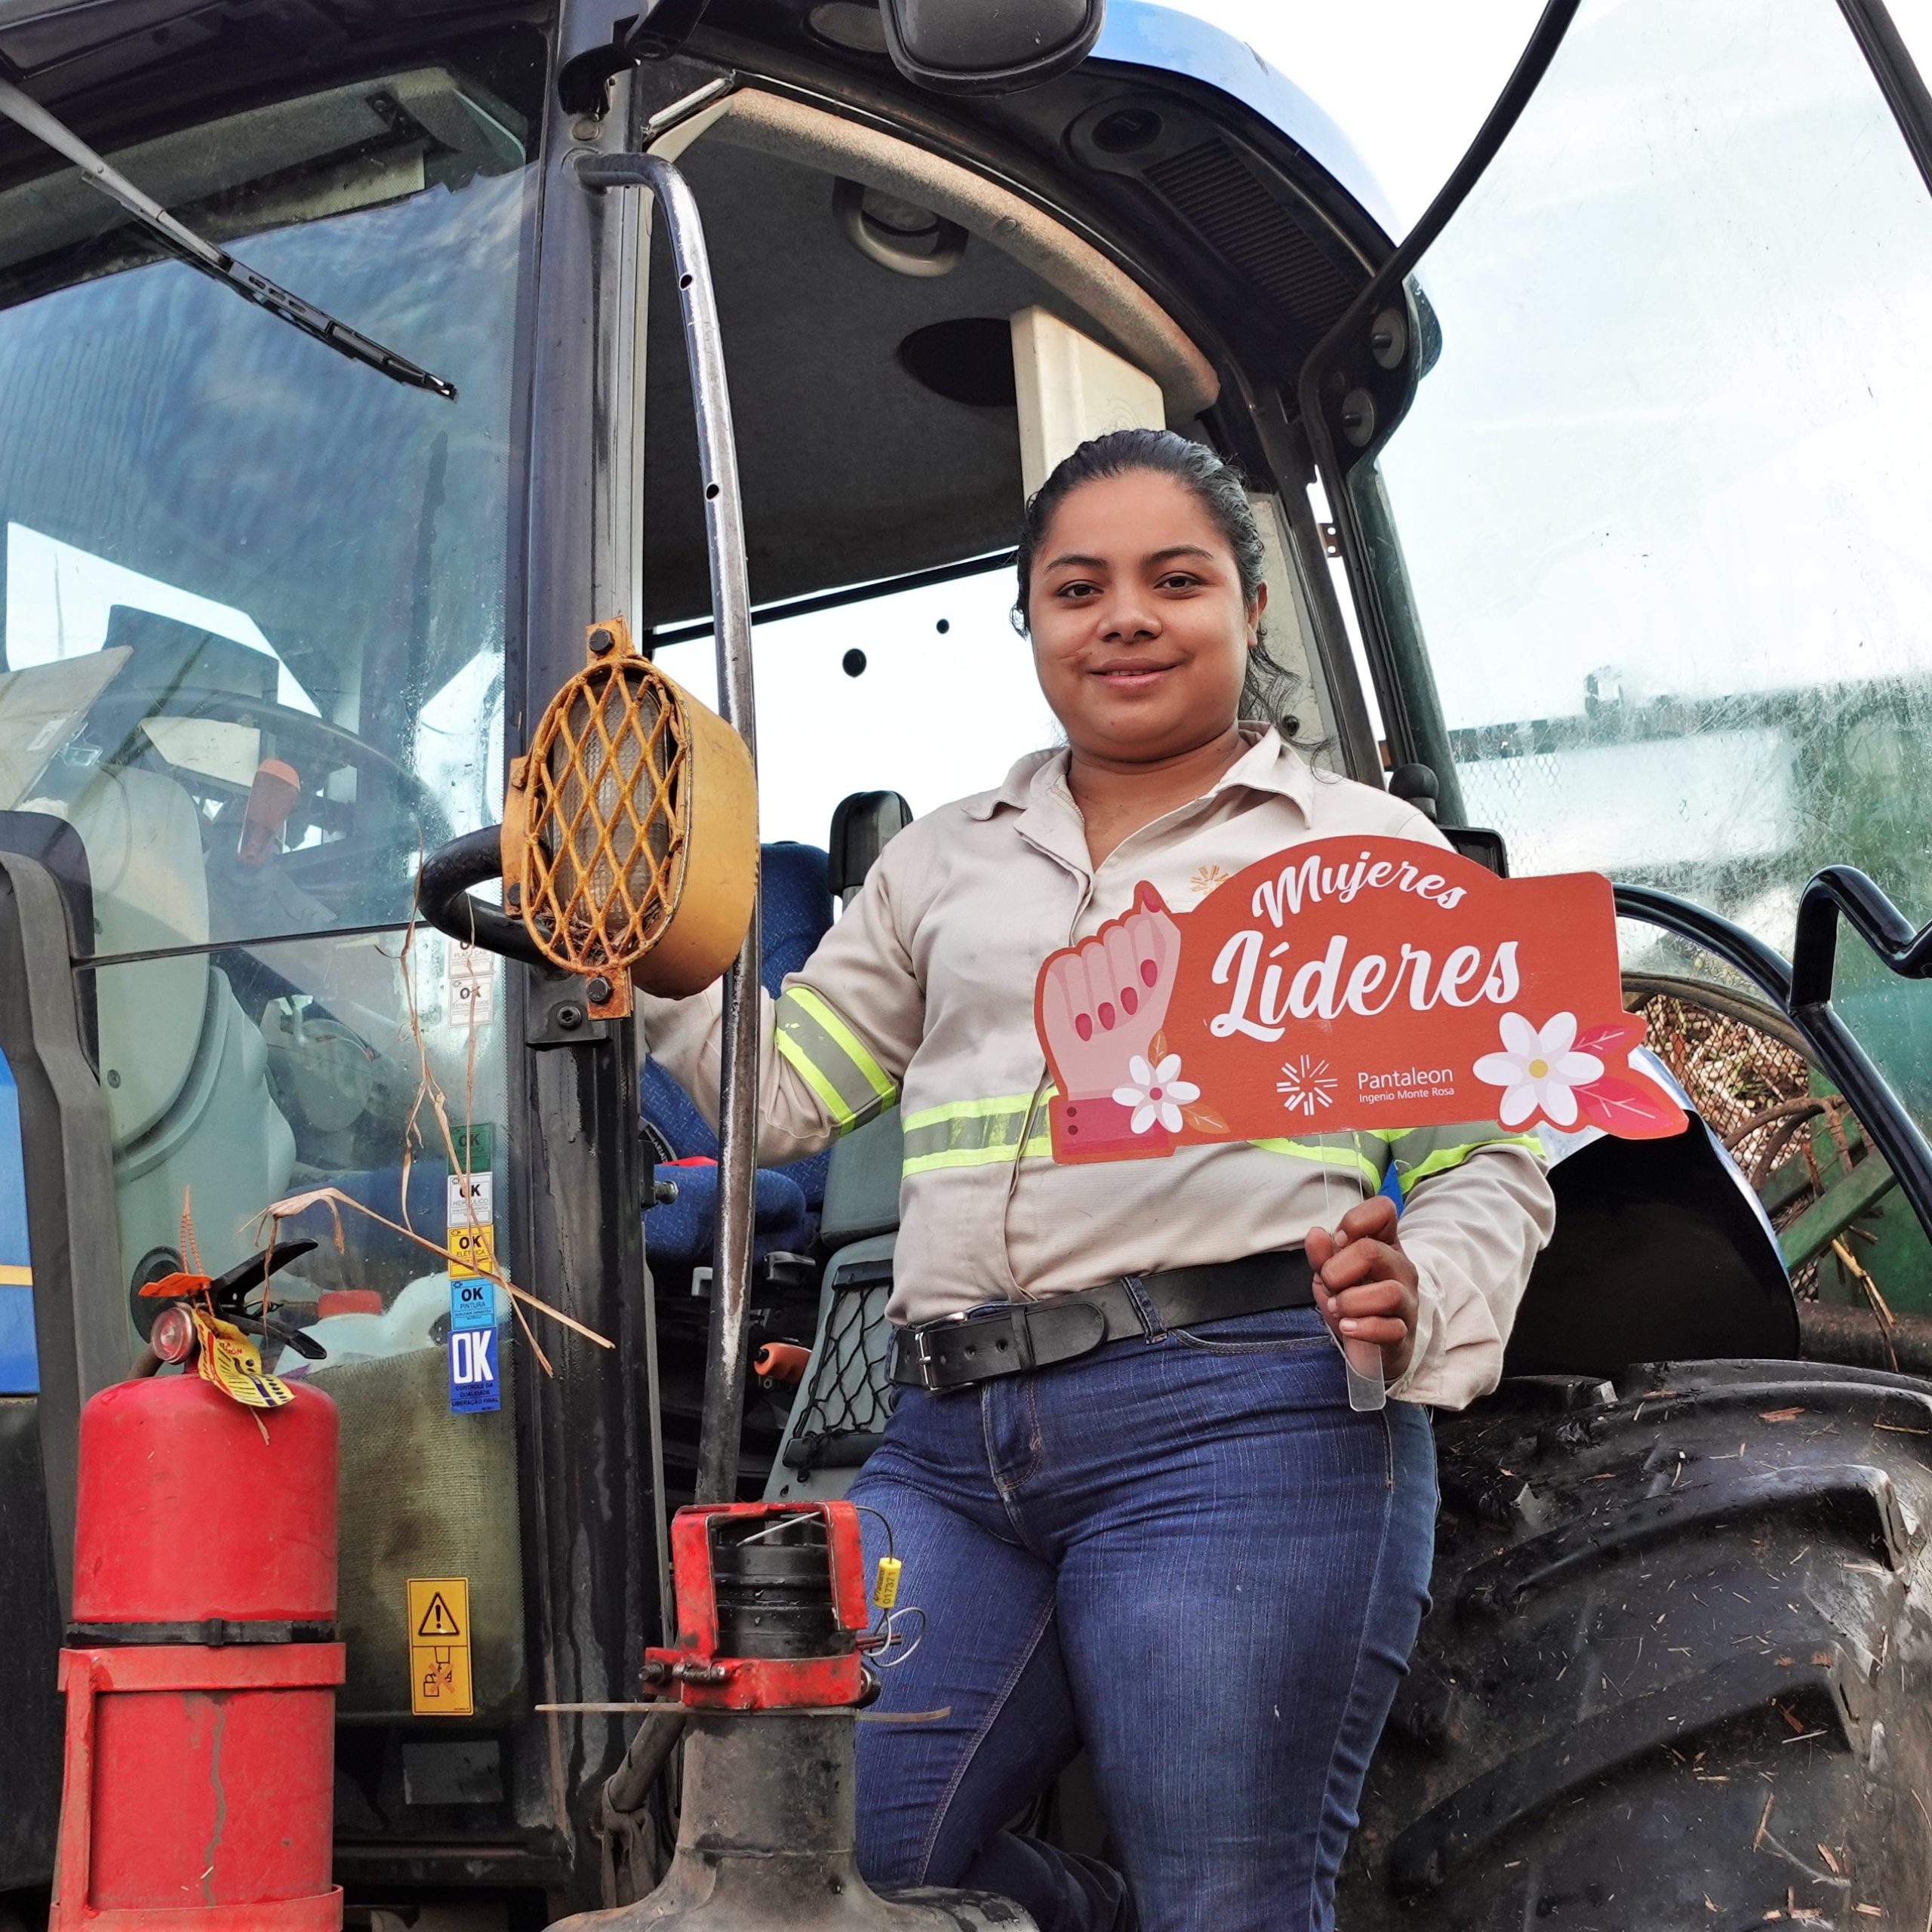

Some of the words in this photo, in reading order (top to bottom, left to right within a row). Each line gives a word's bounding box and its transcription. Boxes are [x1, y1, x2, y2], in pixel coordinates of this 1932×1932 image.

[1252, 850, 1467, 928] Mujeres
[1210, 930, 1520, 1042] Líderes
[1358, 1066, 1454, 1090] Pantaleon
[1358, 1089, 1395, 1105] Ingenio
[1397, 1089, 1429, 1100] Monte
[1431, 1087, 1455, 1097] Rosa
[459, 1133, 481, 1148] OK
[460, 1235, 481, 1250] OK
[460, 1300, 486, 1309] PINTURA
[461, 1286, 484, 1302] OK
[452, 1330, 494, 1383] OK
[883, 1571, 896, 1604] 017371
